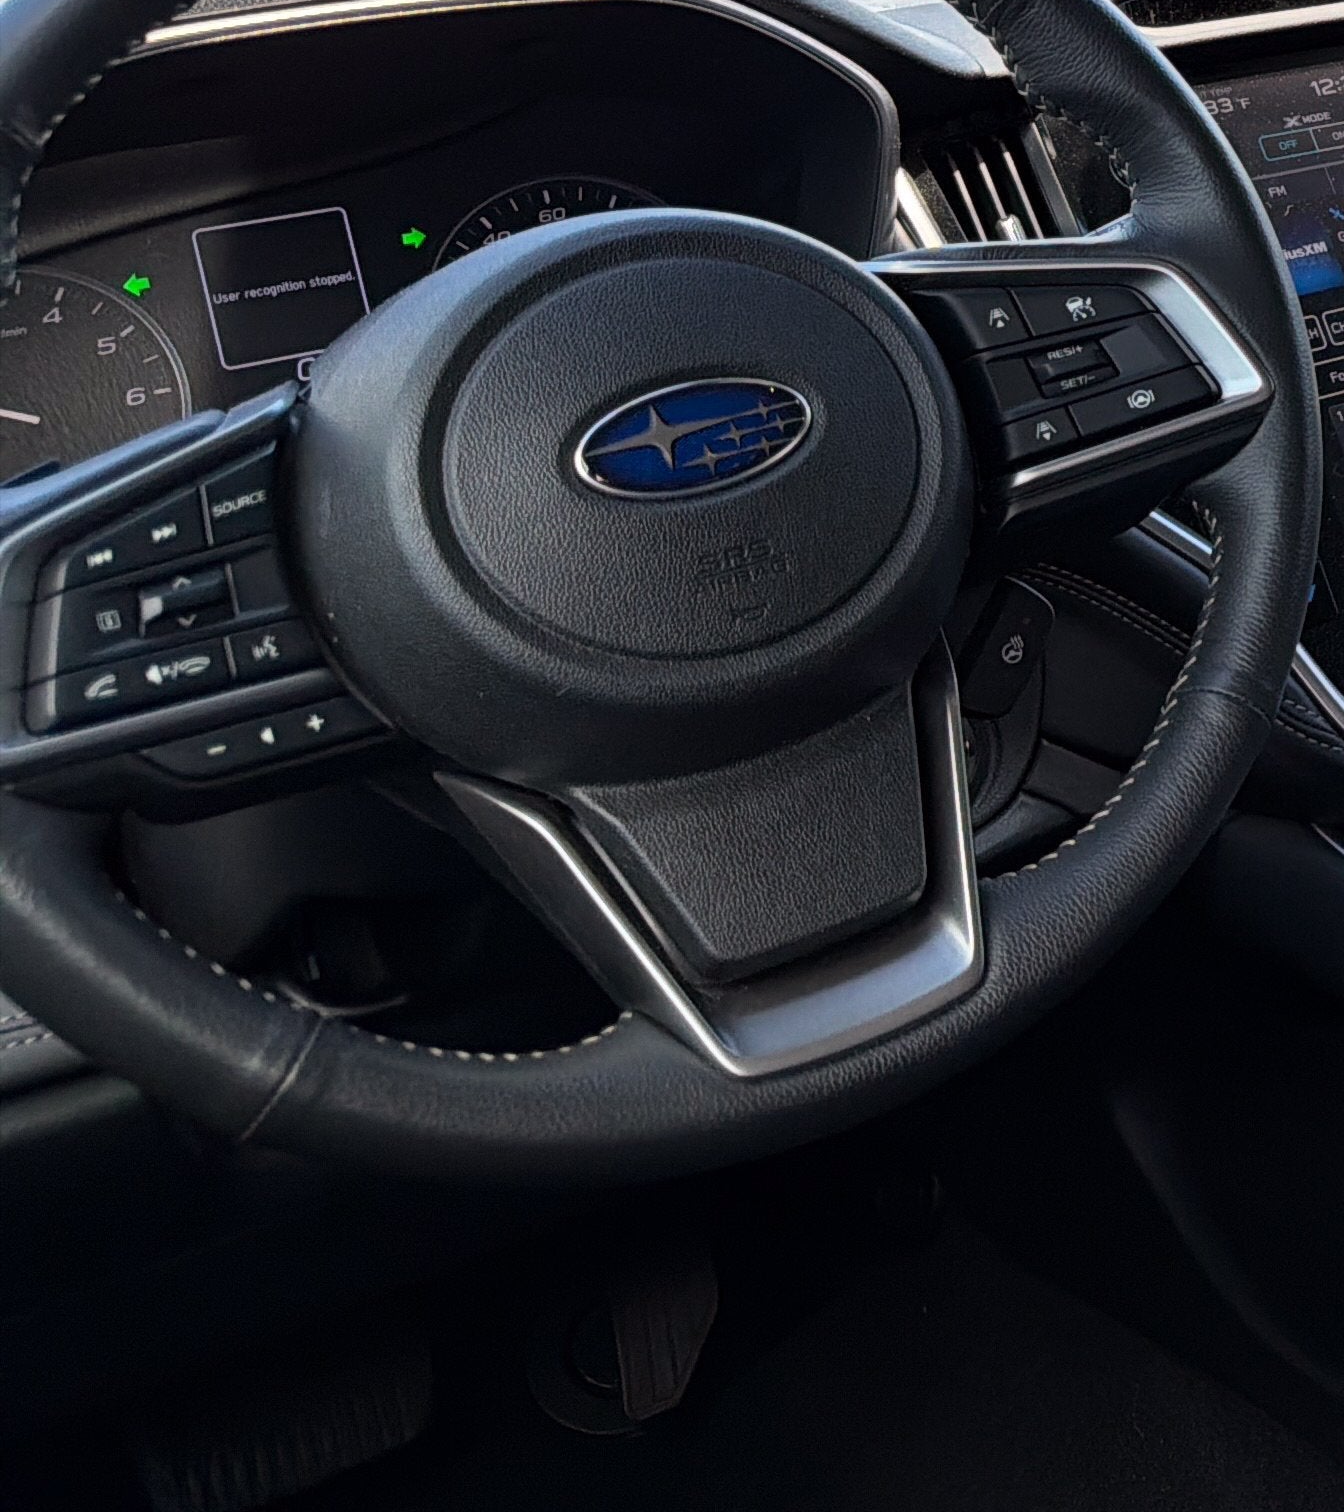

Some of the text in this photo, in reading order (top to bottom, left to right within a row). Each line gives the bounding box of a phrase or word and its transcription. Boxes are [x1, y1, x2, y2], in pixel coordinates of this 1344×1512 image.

[1267, 185, 1288, 199] FM
[538, 207, 567, 224] 60
[1283, 241, 1329, 261] iusXM
[212, 270, 356, 305] User recognition stopped.
[42, 306, 63, 324] 4
[97, 337, 117, 356] 5
[126, 387, 146, 407] 6
[212, 489, 267, 517] SOURCE
